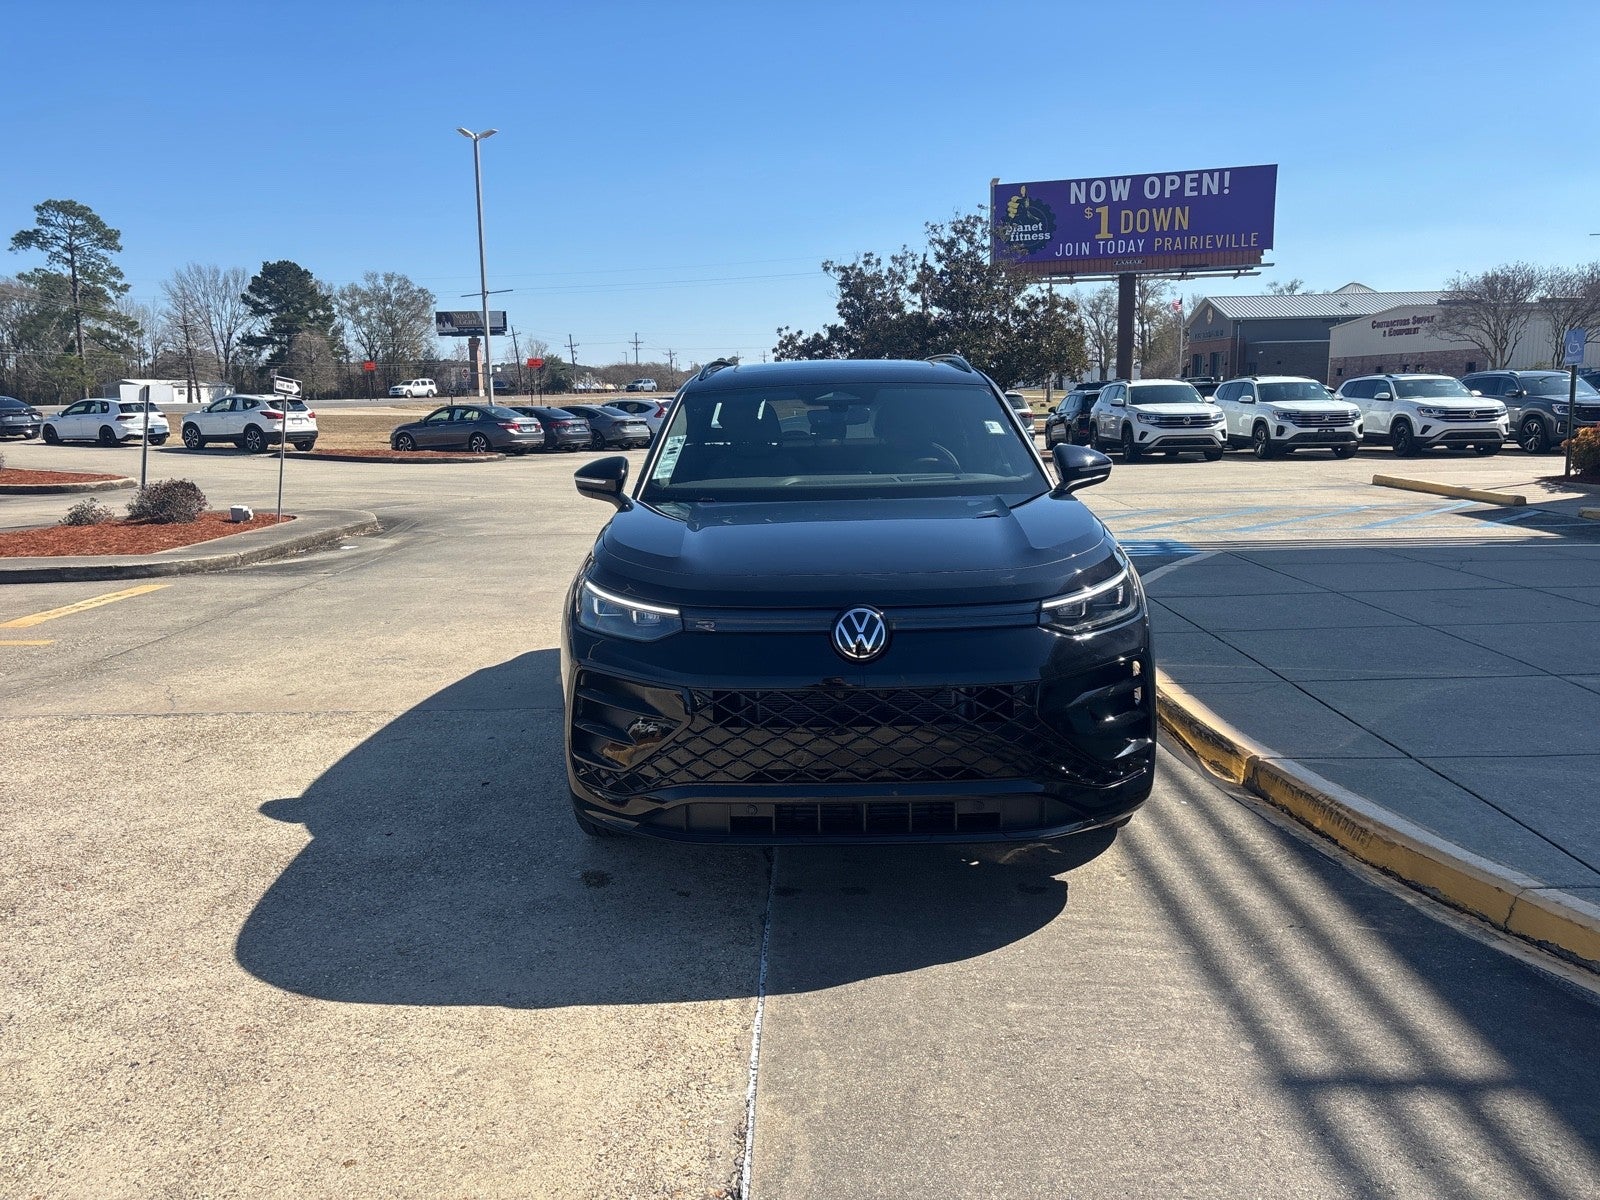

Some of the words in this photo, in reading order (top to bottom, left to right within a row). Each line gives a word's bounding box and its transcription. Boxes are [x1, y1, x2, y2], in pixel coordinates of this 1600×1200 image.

[1070, 178, 1131, 204] NOW
[1143, 171, 1231, 200] OPEN!
[1084, 205, 1114, 240] $1
[1121, 206, 1190, 234] DOWN
[1010, 232, 1051, 242] fitness
[1055, 241, 1090, 257] JOIN
[1099, 238, 1145, 255] TODAY
[1154, 233, 1259, 252] PRAIRIEVILLE
